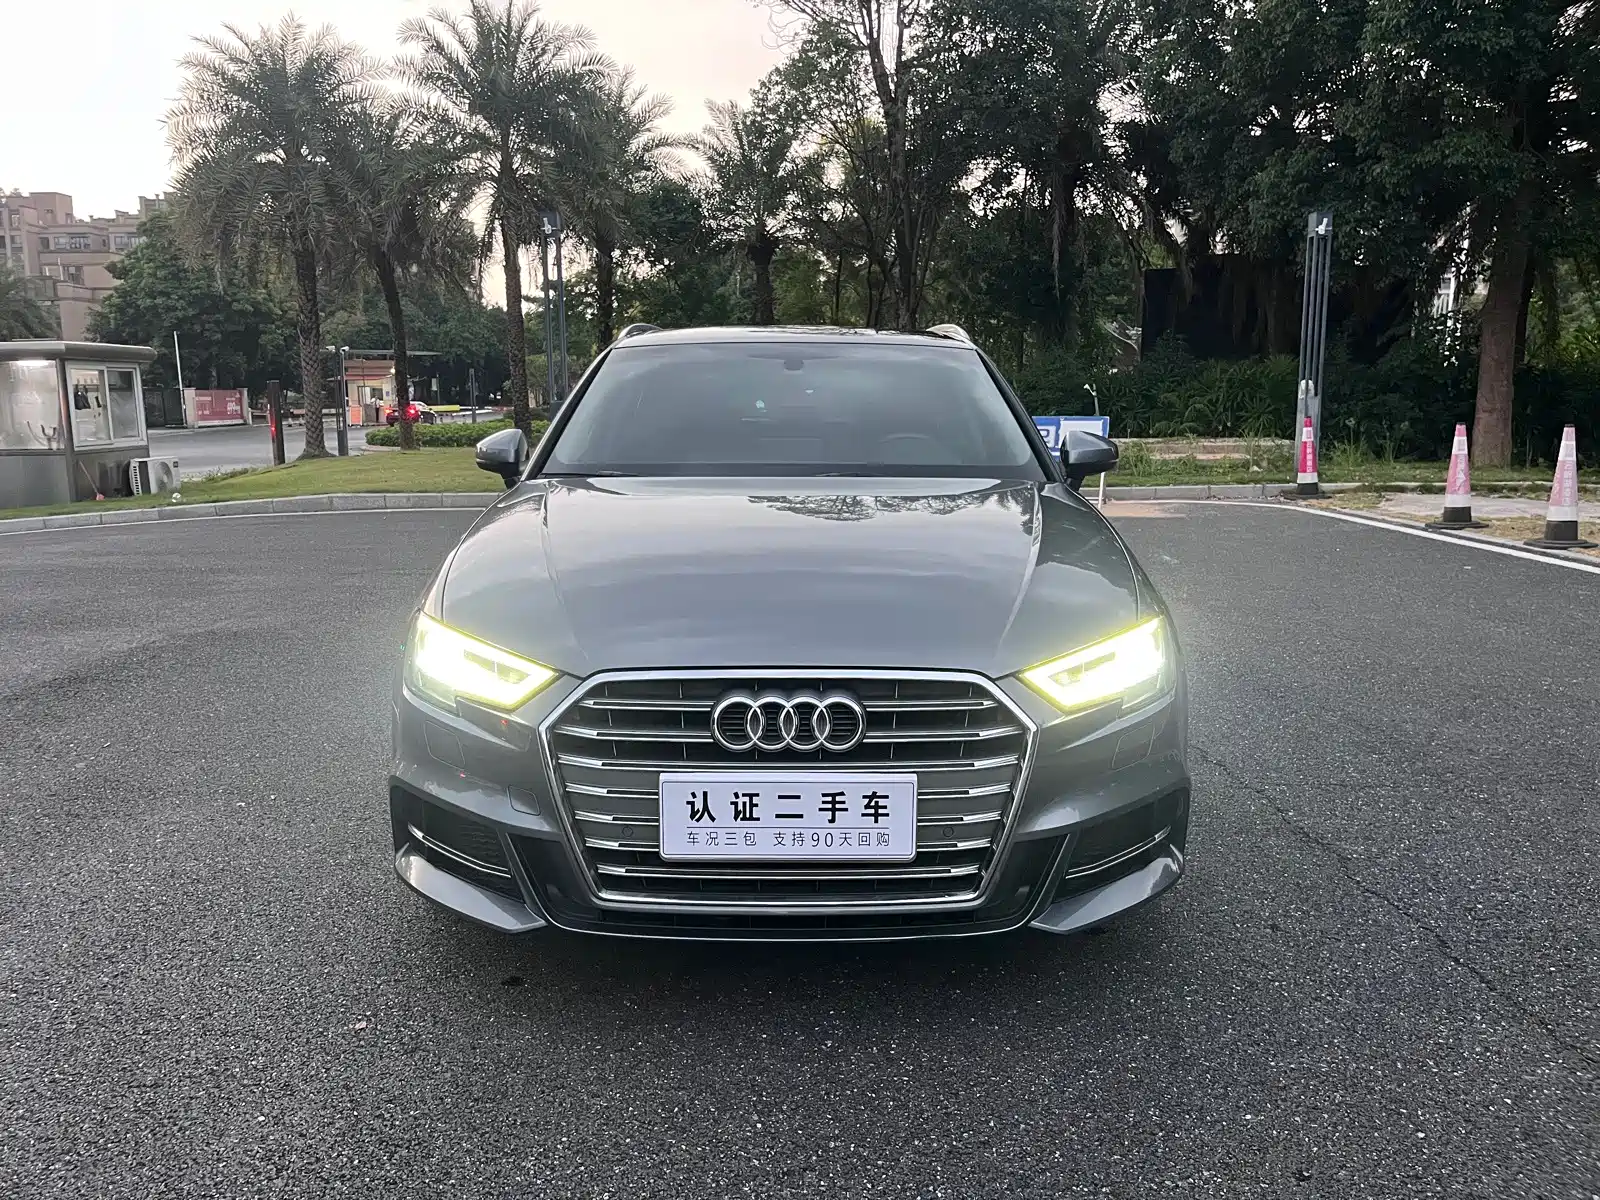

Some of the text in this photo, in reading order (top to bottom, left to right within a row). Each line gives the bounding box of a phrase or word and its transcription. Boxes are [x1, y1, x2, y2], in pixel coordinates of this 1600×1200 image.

[686, 790, 890, 824] 认证二手车
[686, 831, 890, 848] 车况三包 支持90天回购
